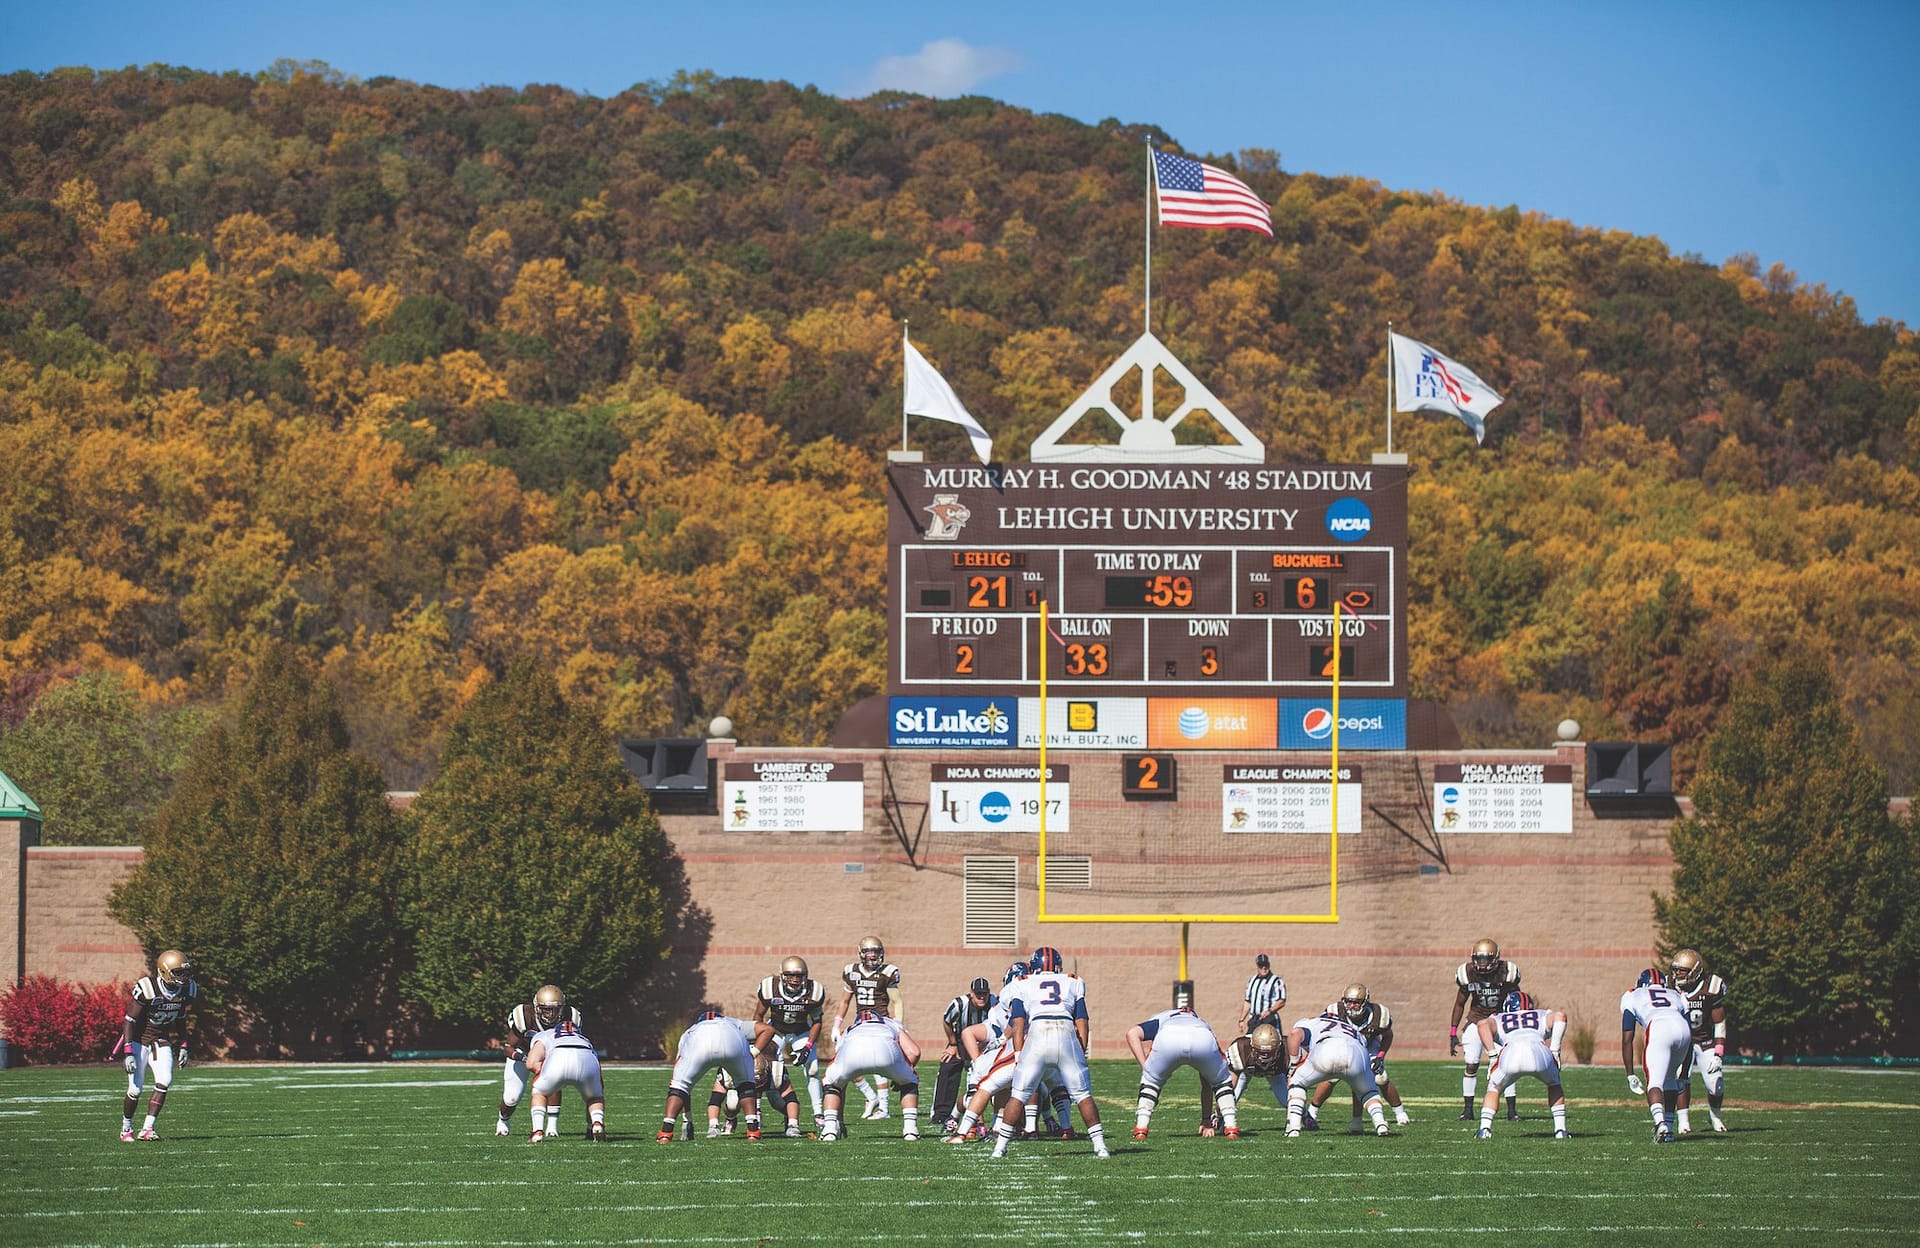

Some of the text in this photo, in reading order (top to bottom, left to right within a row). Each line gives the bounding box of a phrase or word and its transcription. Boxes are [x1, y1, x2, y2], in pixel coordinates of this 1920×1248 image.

[923, 469, 1033, 488] MURRAY
[1038, 469, 1065, 488] H.
[1070, 469, 1211, 489] GOODMAN
[1255, 470, 1372, 491] STADIUM
[998, 508, 1299, 531] LEHIGH UNIVERSITY
[1330, 518, 1370, 531] NCAA
[1094, 553, 1202, 570] TIME TO PLAY
[1272, 554, 1343, 568] BUCKNELL
[968, 575, 1007, 607] 21
[1028, 589, 1037, 605] 1
[1144, 576, 1193, 607] :59
[1297, 577, 1316, 609] 6
[1255, 592, 1265, 608] 3
[931, 618, 997, 635] PERIOD
[1061, 619, 1111, 635] BALL ON
[1188, 619, 1230, 636] DOWN
[1298, 620, 1324, 636] YDS
[1345, 620, 1365, 637] GO
[956, 645, 973, 674] 2
[1066, 643, 1108, 675] 33
[1200, 648, 1219, 676] 3
[896, 708, 925, 732] St
[1214, 715, 1247, 731] at&t
[941, 738, 970, 746] HEALTH
[971, 738, 1008, 746] NETWORK
[1024, 735, 1058, 744] ALIN
[1117, 735, 1142, 744] INC.
[754, 763, 834, 773] LAMBERT CUP
[947, 768, 980, 778] NCAA
[1138, 757, 1158, 789] 2
[1233, 769, 1278, 779] LEAGUE
[1461, 765, 1544, 774] NCAA PLAYOFF
[761, 772, 827, 782] CHAMPIONS
[1462, 774, 1544, 784] APPEARANCES
[784, 784, 803, 792] 1977
[784, 808, 805, 816] 2001
[784, 819, 804, 827] 2011
[857, 988, 875, 1005] 21
[1040, 981, 1061, 1005] 3
[1648, 989, 1671, 1008] 5
[1502, 1012, 1539, 1034] 88
